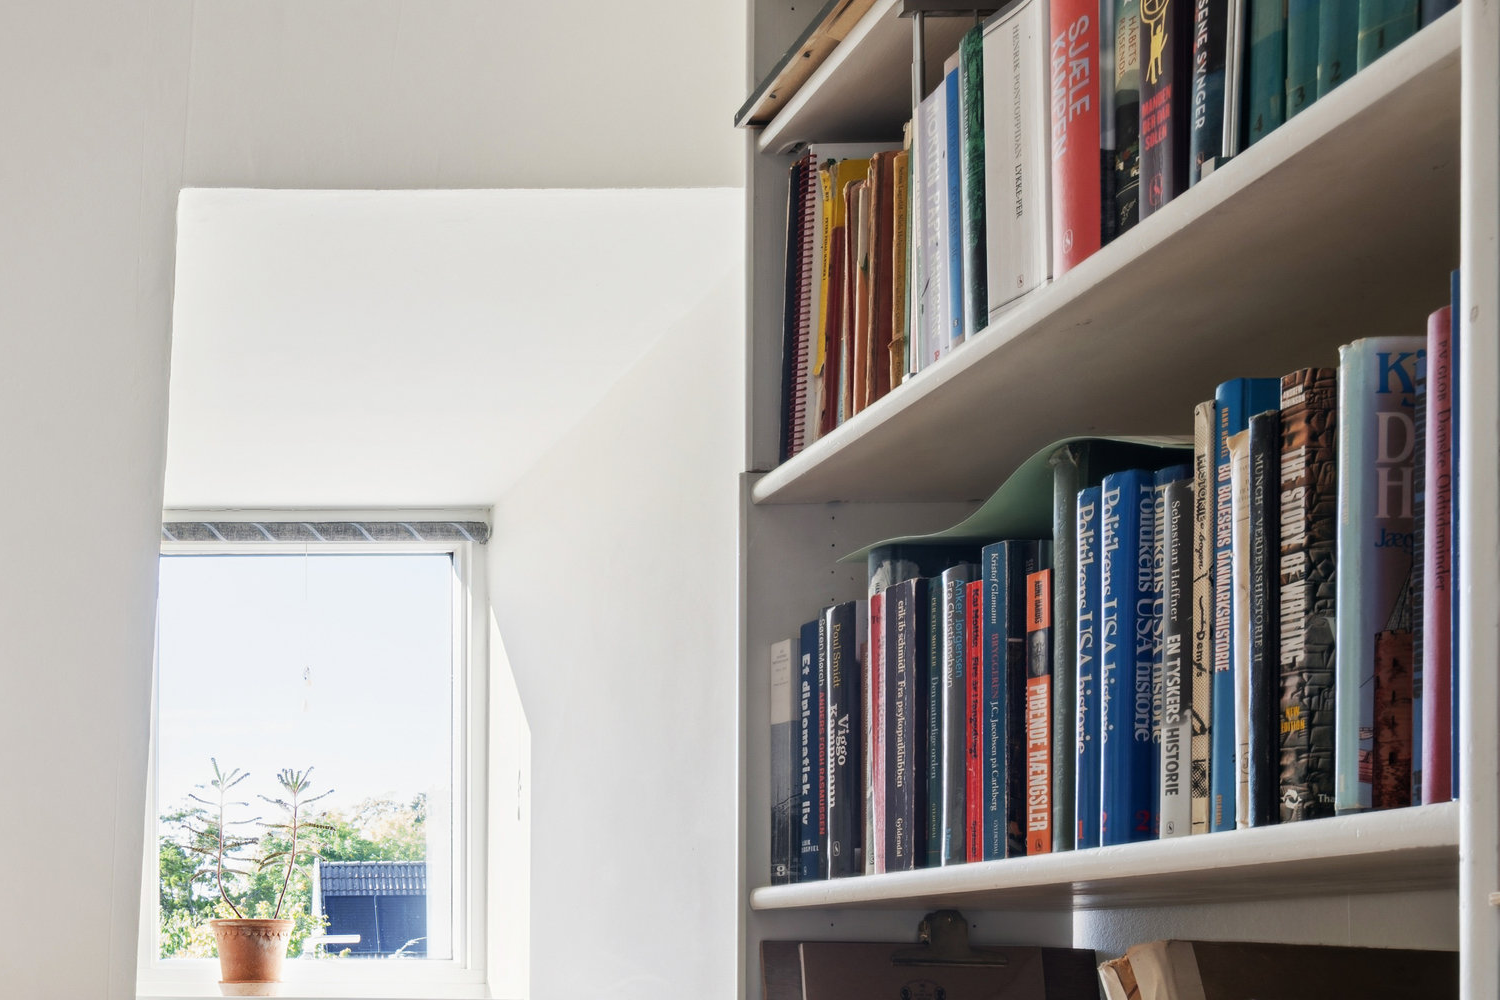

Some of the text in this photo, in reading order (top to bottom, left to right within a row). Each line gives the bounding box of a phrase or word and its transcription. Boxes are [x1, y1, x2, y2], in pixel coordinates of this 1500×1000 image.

[1068, 15, 1090, 122] SJÆLE
[1128, 15, 1137, 66] HÅBETS
[1330, 61, 1342, 82] 2
[1377, 29, 1386, 50] 1
[1012, 24, 1024, 219] HENRIK PONTOPPIDAN LYKKE-PER
[1052, 32, 1068, 162] KAMPEN
[1194, 51, 1208, 131] SYNGER
[1294, 88, 1306, 108] 3
[926, 101, 940, 247] MORTEN PAPE
[1218, 463, 1231, 482] BO
[1435, 408, 1450, 467] Danske
[1217, 484, 1231, 548] BOJESENS
[1253, 452, 1264, 505] MUNCH
[1078, 501, 1095, 609] Politikens
[1102, 486, 1121, 597] Politikens
[1280, 445, 1306, 669] THE STORY OF WRITING
[1434, 472, 1451, 591] Oldtidsminder
[1215, 550, 1233, 673] DANMARKSHISTORIE
[1253, 516, 1264, 649] VERDENSHISTORIE
[832, 622, 842, 688] Poul Smidt
[946, 581, 955, 689] Fra Christianshavn
[954, 579, 965, 679] Anker Jørgensen
[1078, 610, 1094, 669] USA
[1102, 597, 1118, 655] USA
[1165, 500, 1181, 796] Sebastian Haffner EN TYSKERS HISTORIE
[895, 601, 906, 787] erik ib schmidt Fra psykopatklubben
[930, 696, 939, 745] naturlige
[931, 676, 939, 694] Den
[989, 553, 999, 812] Kristof Glamann BRYGGEREN Jacobsen på Carlsberg
[1078, 673, 1093, 754] historie
[1285, 706, 1301, 718] NEW
[801, 653, 811, 826] Et diplomatisk liv
[828, 703, 838, 808] Kampmann
[835, 713, 850, 766] Viggo
[930, 748, 939, 779] orden
[1028, 683, 1048, 832] PIBENDE HÆNGSLER
[1280, 719, 1305, 735] EDITION
[895, 816, 904, 858] Gyldendal
